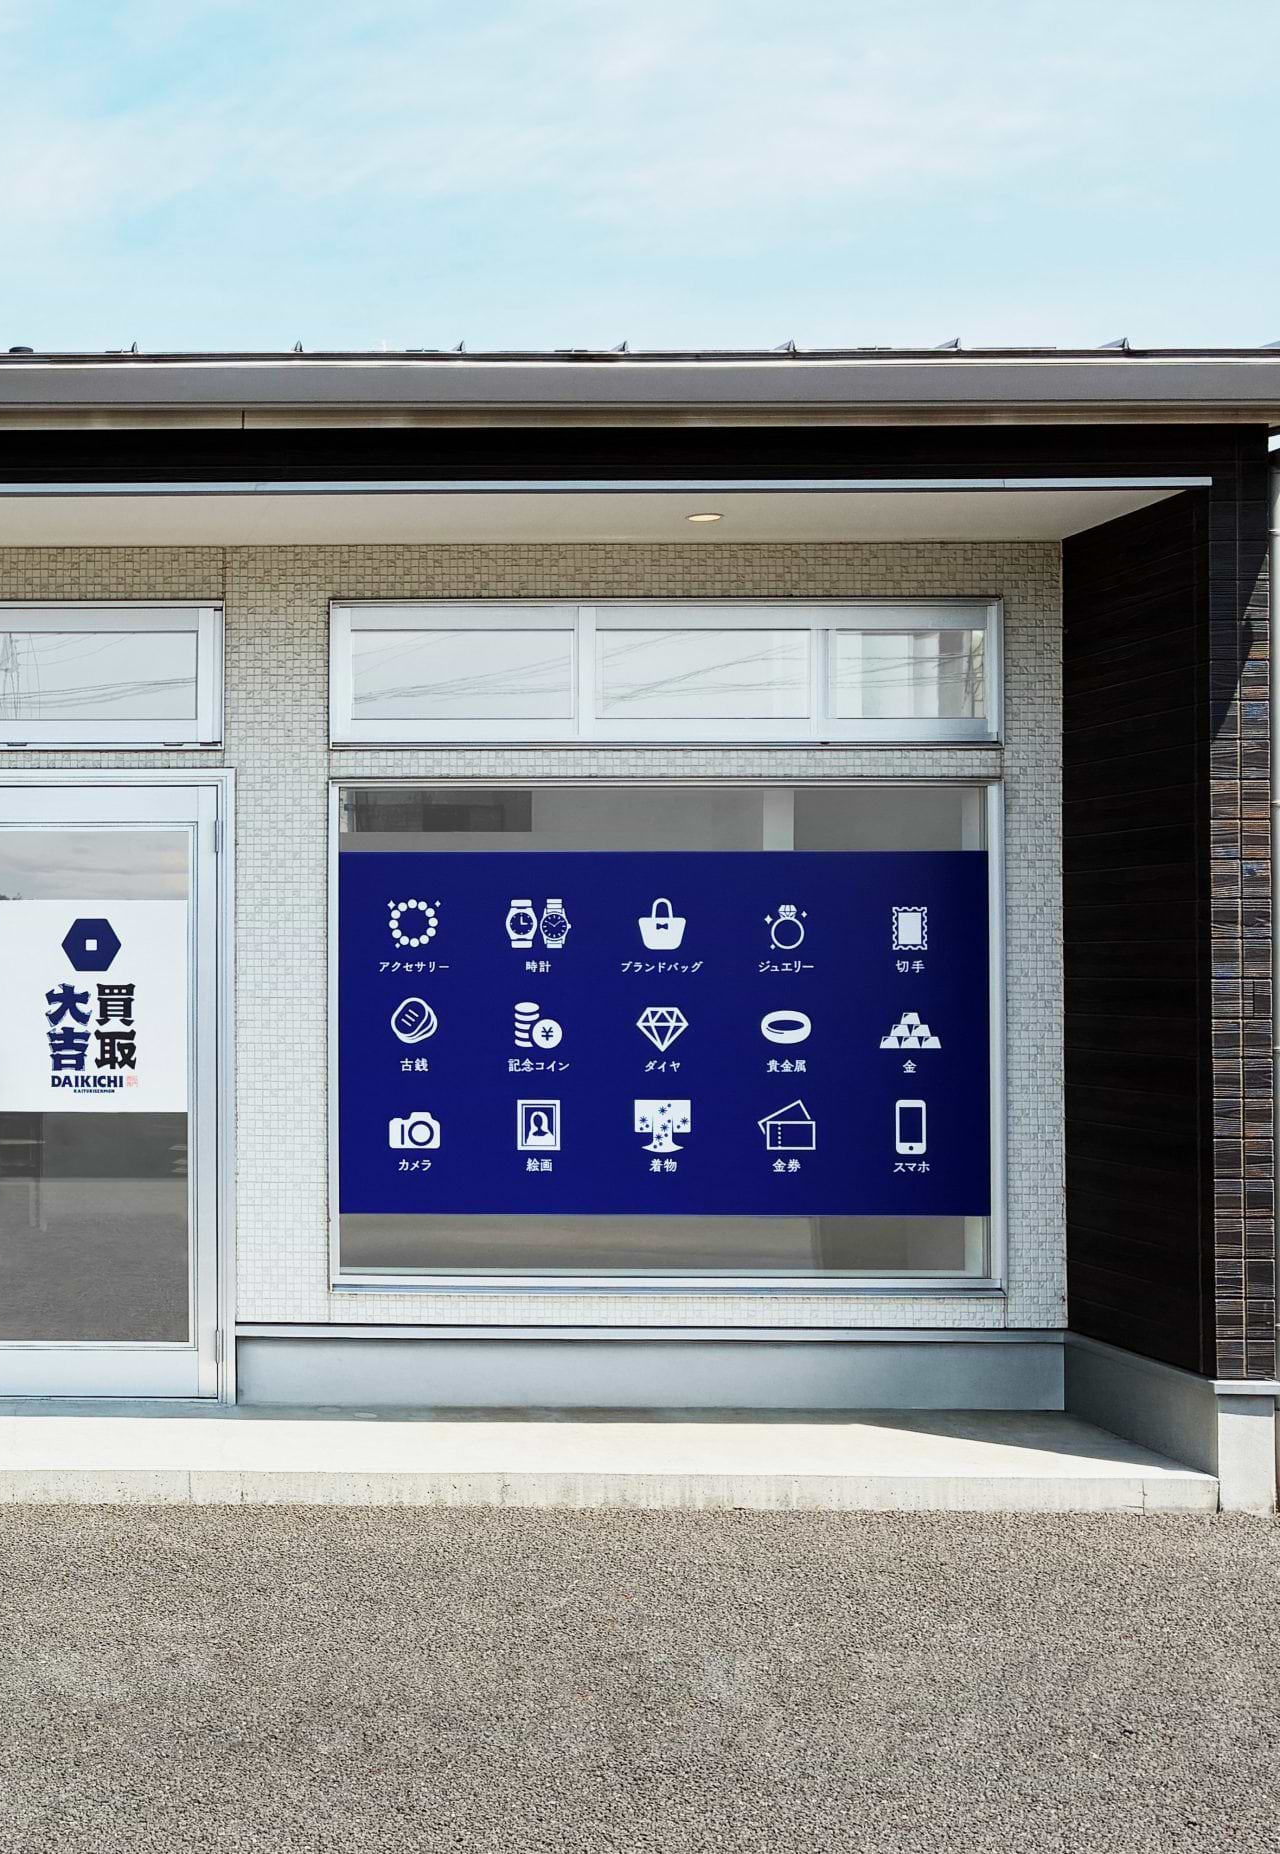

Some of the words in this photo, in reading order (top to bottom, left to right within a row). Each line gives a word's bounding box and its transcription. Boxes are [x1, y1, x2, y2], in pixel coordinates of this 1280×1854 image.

[378, 960, 450, 973] アクセサリー
[525, 960, 551, 973] 時計
[621, 960, 704, 973] ブランドバッグ
[758, 960, 815, 973] ジュエリー
[895, 960, 925, 973] 切手
[400, 1058, 429, 1072] 古銭
[508, 1058, 570, 1072] 記念コイン
[644, 1060, 681, 1073] ダイヤ
[766, 1059, 807, 1073] 貴金属
[902, 1059, 918, 1074] 金
[50, 1075, 124, 1088] DAIKICHI
[398, 1158, 432, 1172] カメラ
[526, 1158, 553, 1172] 絵画
[649, 1158, 678, 1173] 着物
[772, 1158, 801, 1173] 金券
[893, 1160, 930, 1173] スマホ
